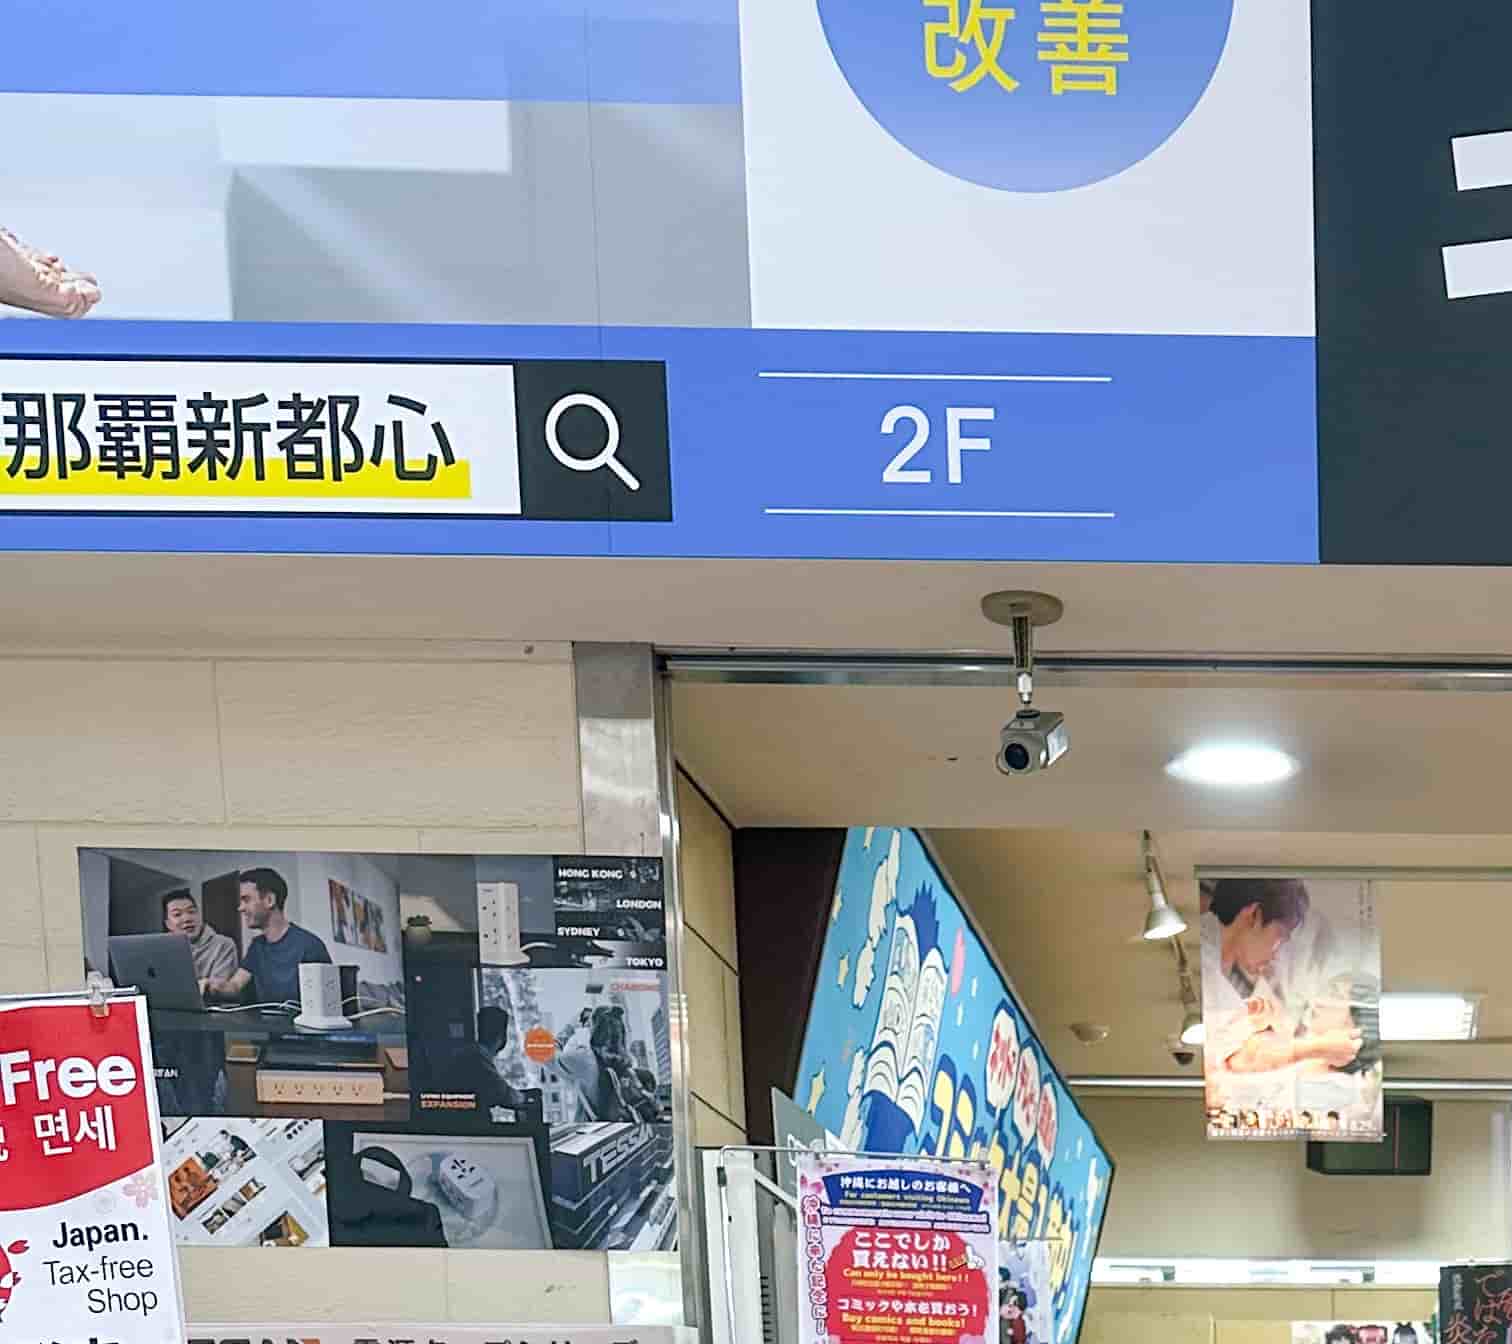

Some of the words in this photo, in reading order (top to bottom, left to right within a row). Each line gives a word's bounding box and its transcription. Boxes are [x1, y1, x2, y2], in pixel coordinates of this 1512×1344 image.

[922, 0, 1130, 98] 改善
[2, 390, 457, 485] 那覇新都心
[880, 405, 997, 486] 2F
[558, 868, 590, 879] HONG
[591, 869, 624, 880] KONG
[616, 899, 663, 910] LONDON
[557, 927, 600, 938] SYDNEY
[626, 957, 664, 968] TOKYO
[0, 1052, 137, 1101] Free
[34, 1110, 118, 1155] 면세
[51, 1220, 150, 1251] Japan.
[854, 1231, 952, 1250] ここでしか
[43, 1255, 154, 1287] Tax-free
[86, 1286, 160, 1317] Shop
